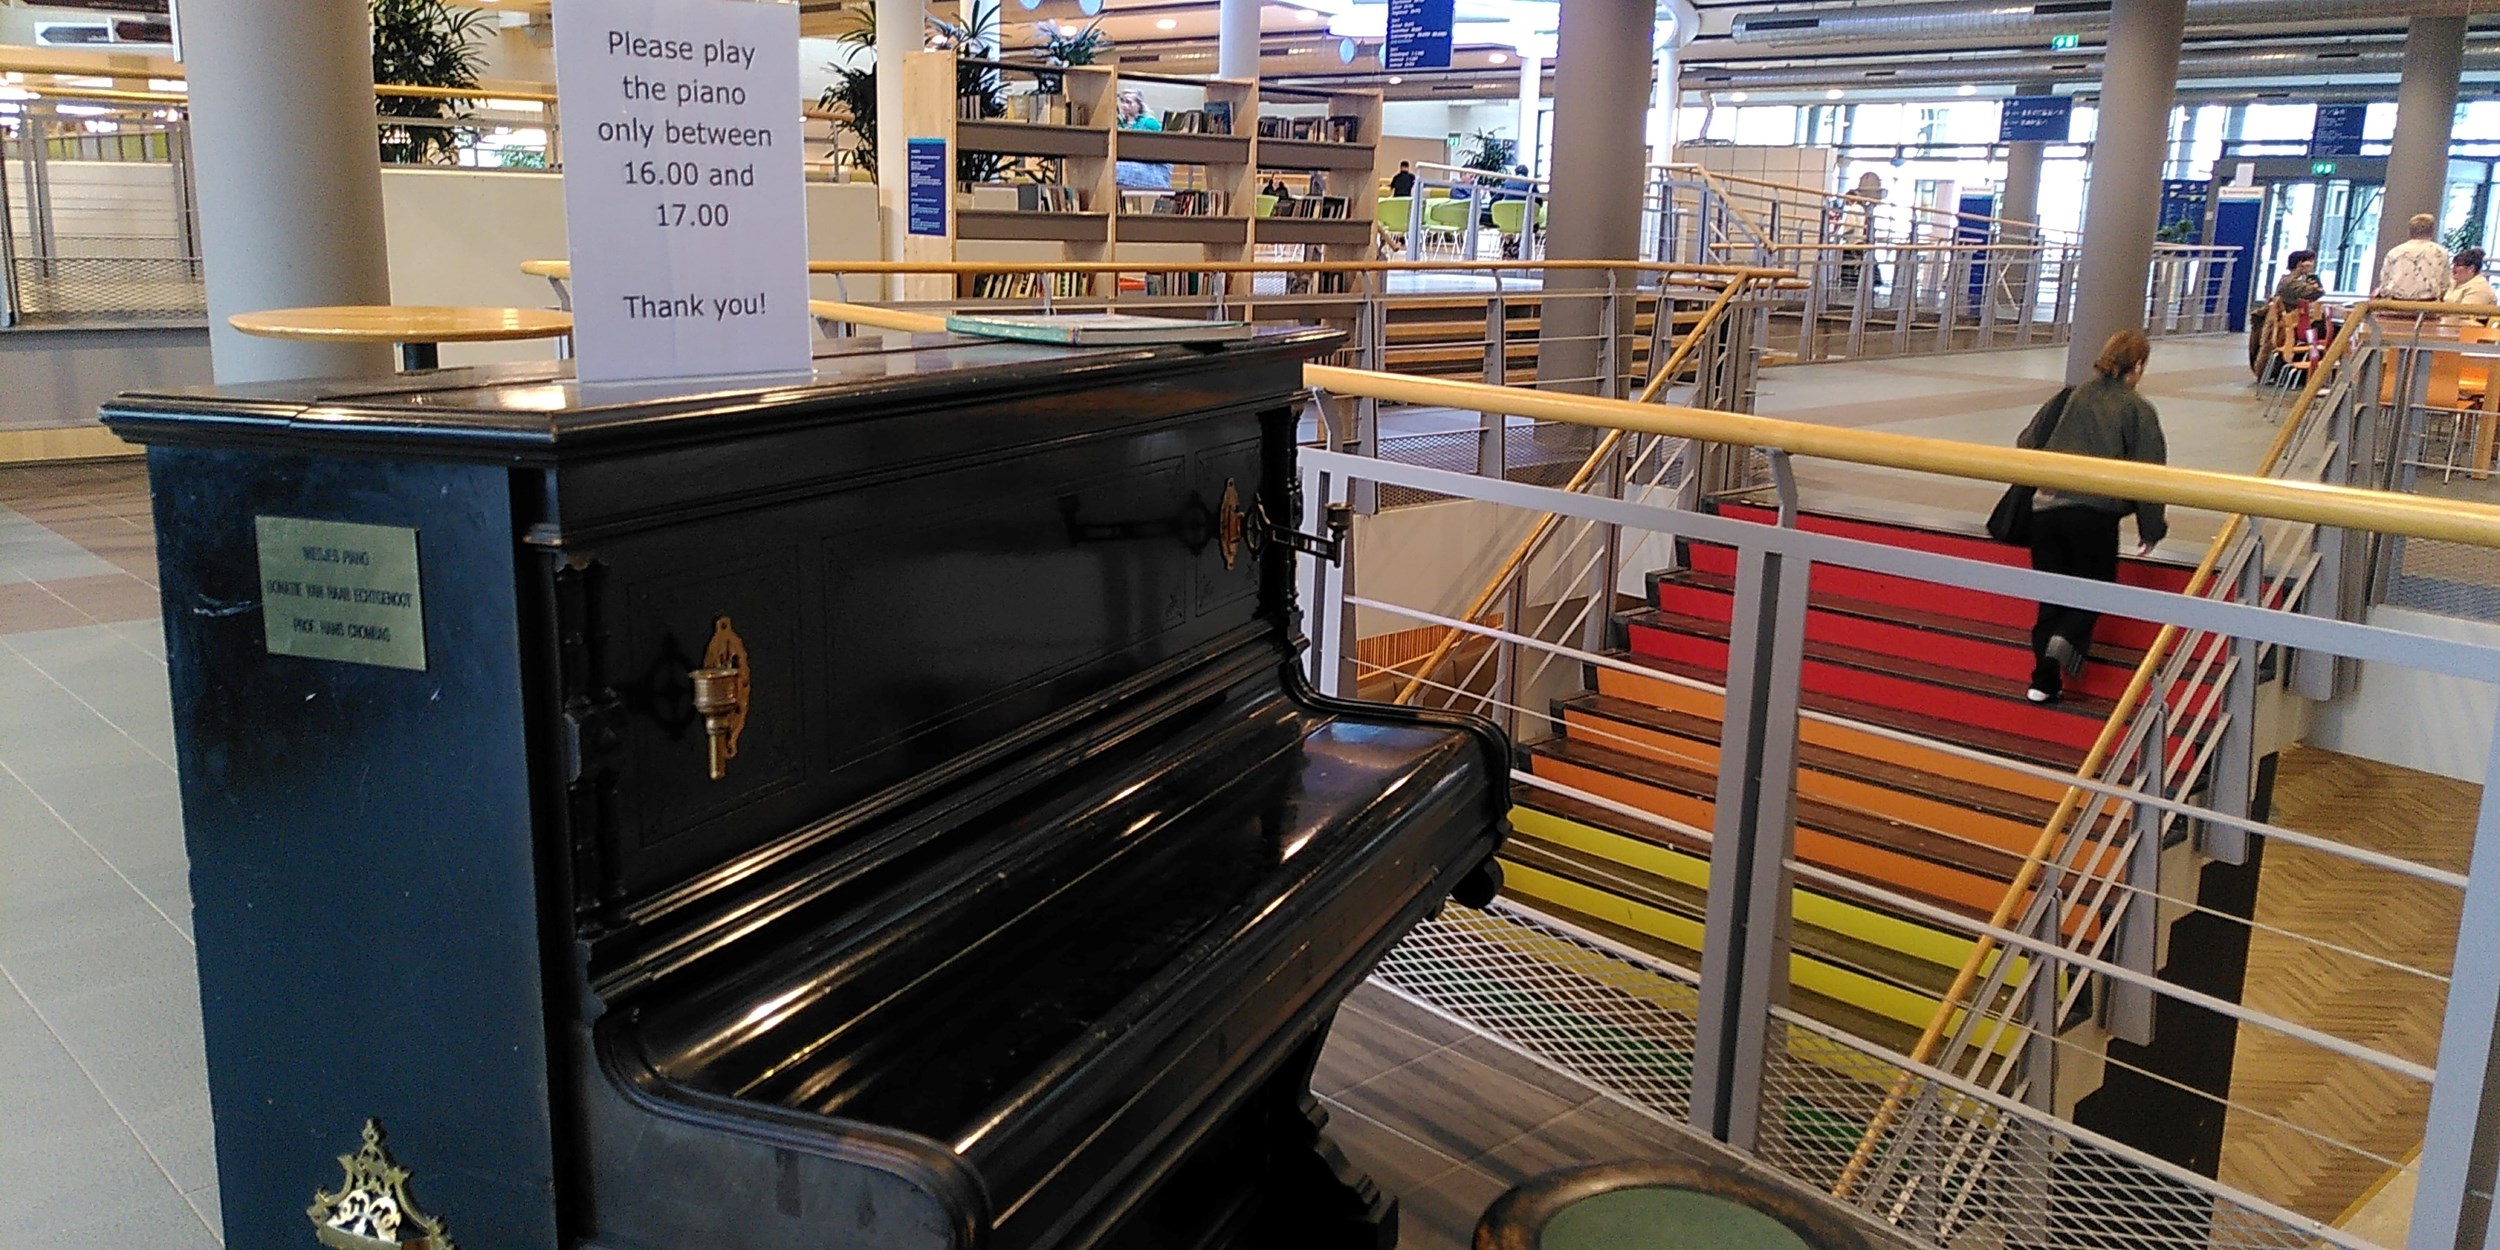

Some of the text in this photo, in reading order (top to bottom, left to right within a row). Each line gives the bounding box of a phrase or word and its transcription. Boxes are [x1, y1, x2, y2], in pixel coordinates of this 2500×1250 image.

[608, 31, 756, 71] Please play
[622, 75, 746, 108] the piano
[598, 117, 772, 149] only between
[624, 161, 754, 187] 16.00 and
[657, 203, 729, 227] 17.00
[622, 292, 766, 322] Thank you!
[342, 549, 370, 566] PIANO
[266, 579, 302, 597] DONATIE
[305, 583, 324, 599] VAN
[353, 587, 413, 608] ECHTGENOOT
[319, 620, 344, 637] HANS
